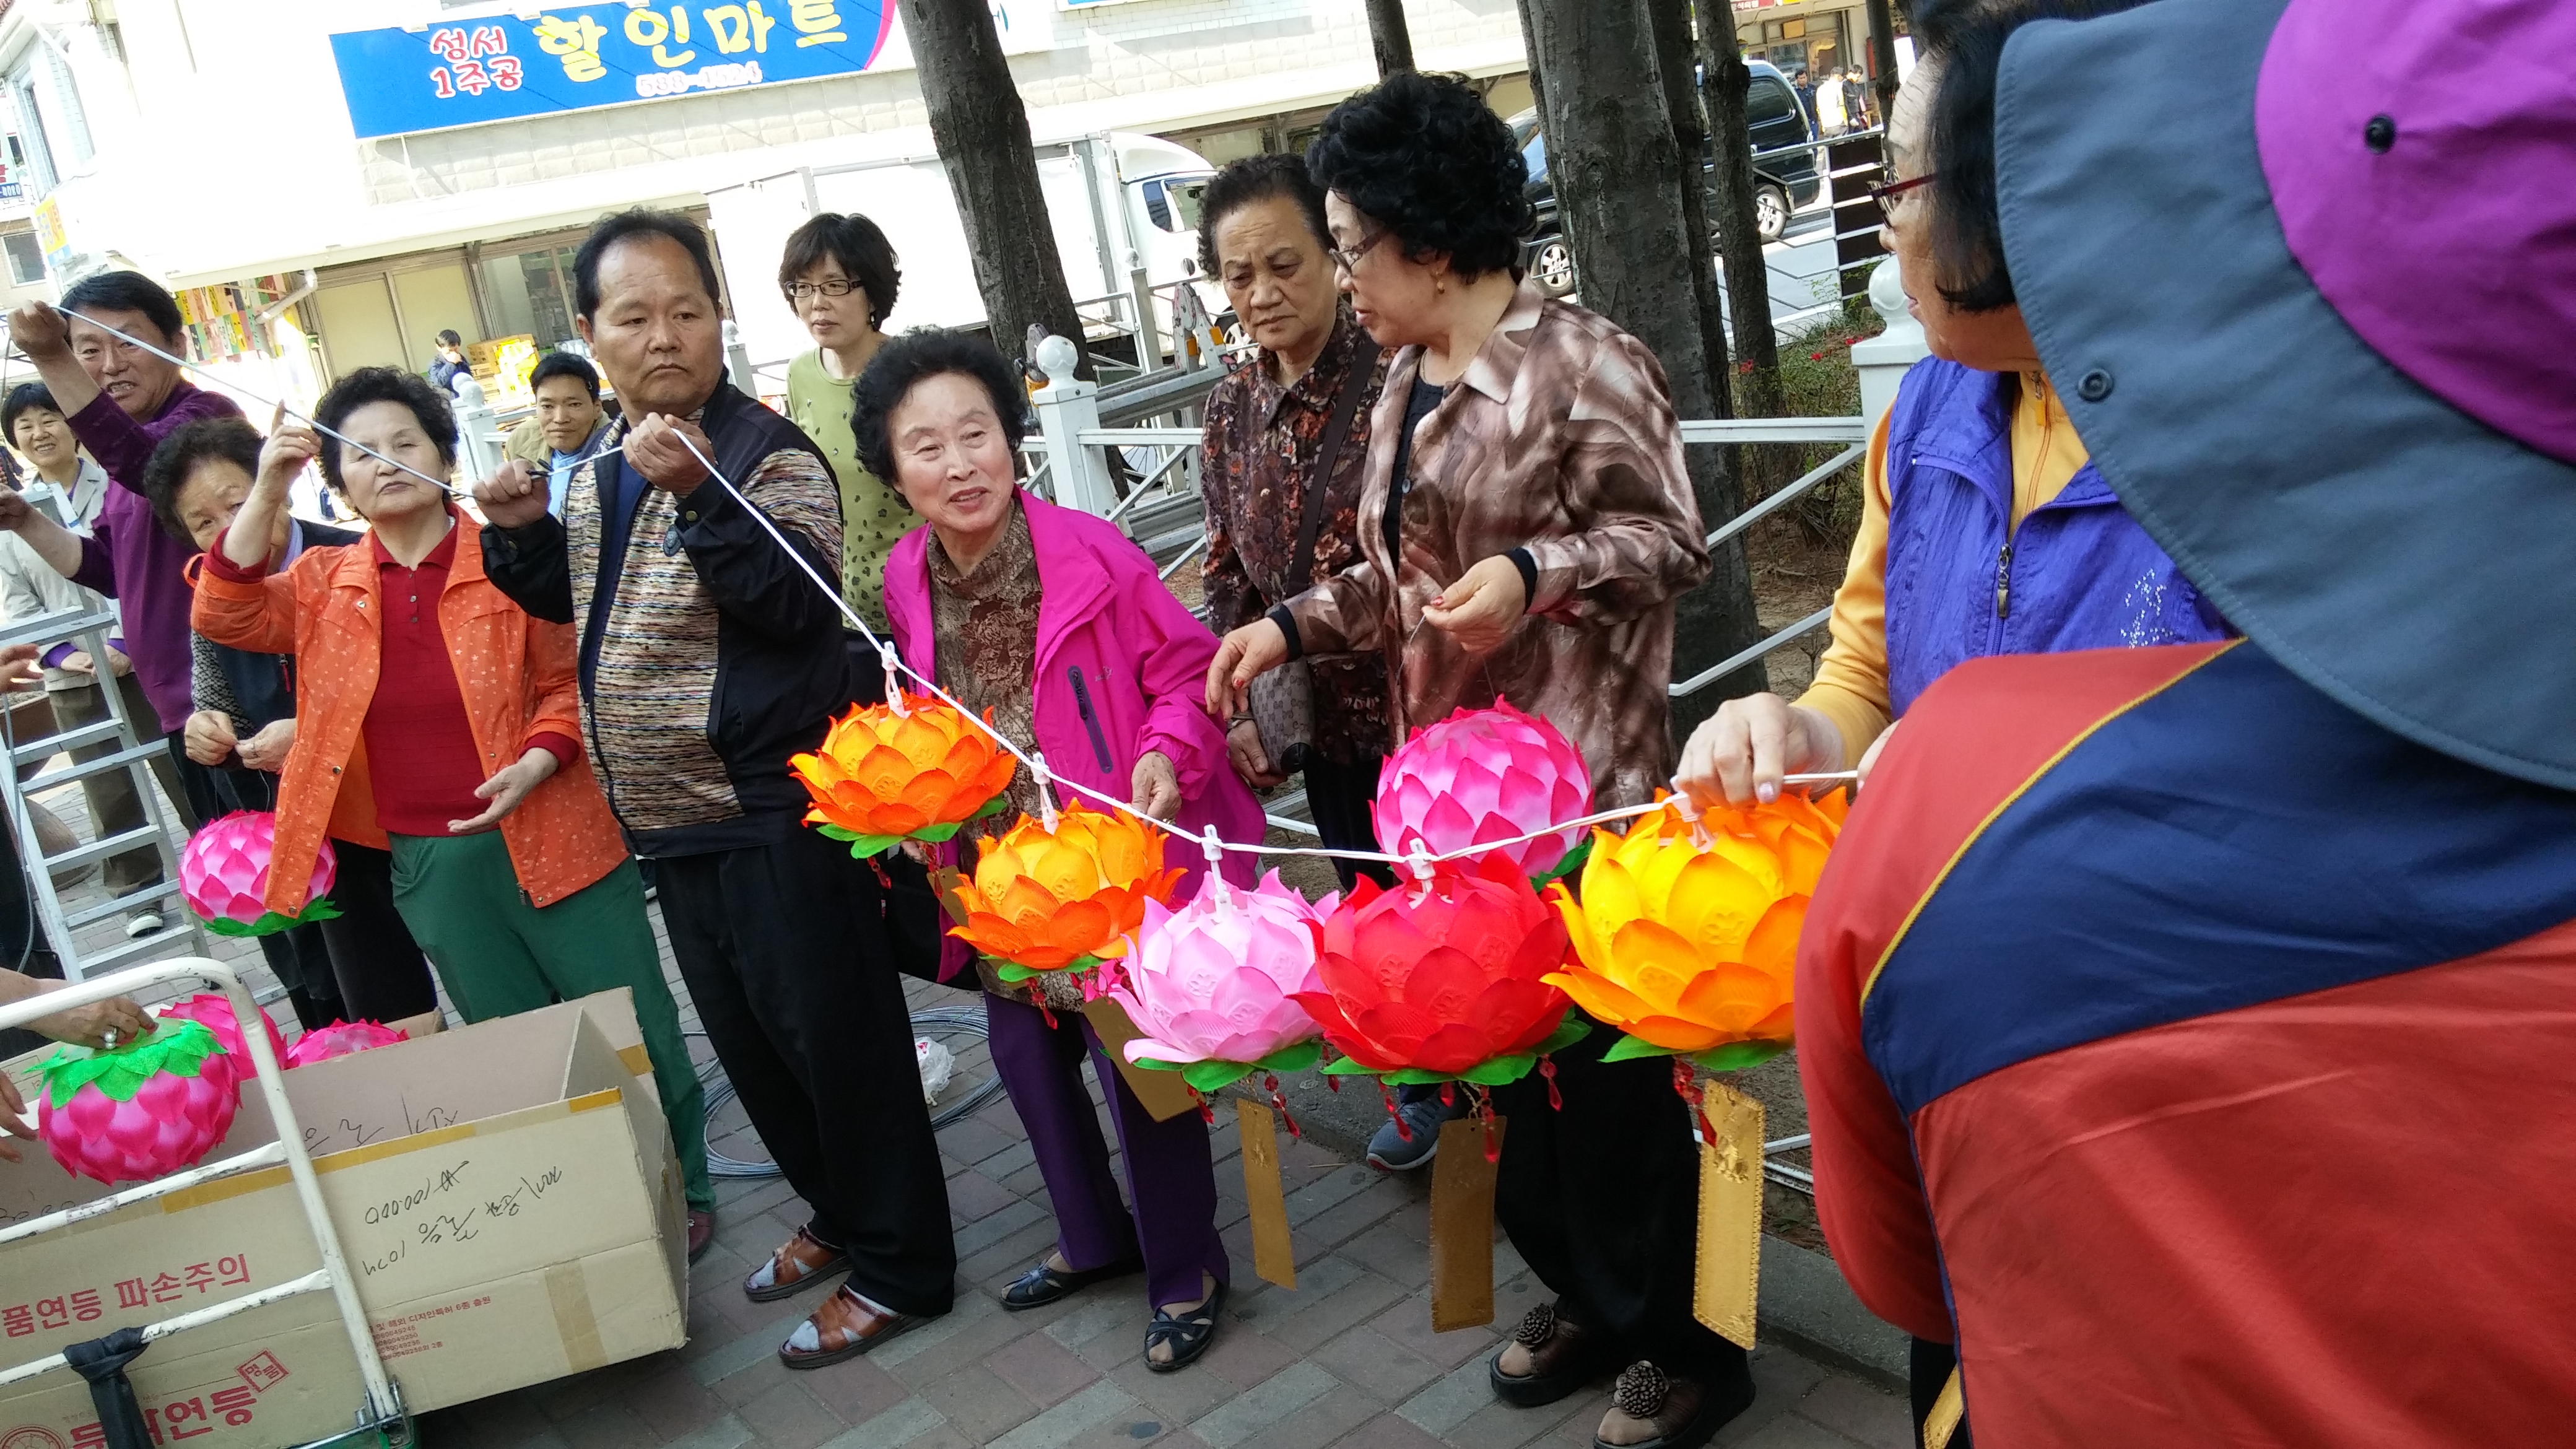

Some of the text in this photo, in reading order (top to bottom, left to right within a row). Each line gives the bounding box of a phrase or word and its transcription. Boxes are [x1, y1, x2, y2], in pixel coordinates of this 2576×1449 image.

[430, 25, 507, 62] 성서
[533, 0, 848, 82] 할인마트
[430, 56, 523, 98] 1주공
[637, 61, 763, 97] 588-4524
[1, 1253, 250, 1338] 품연등 파손주의
